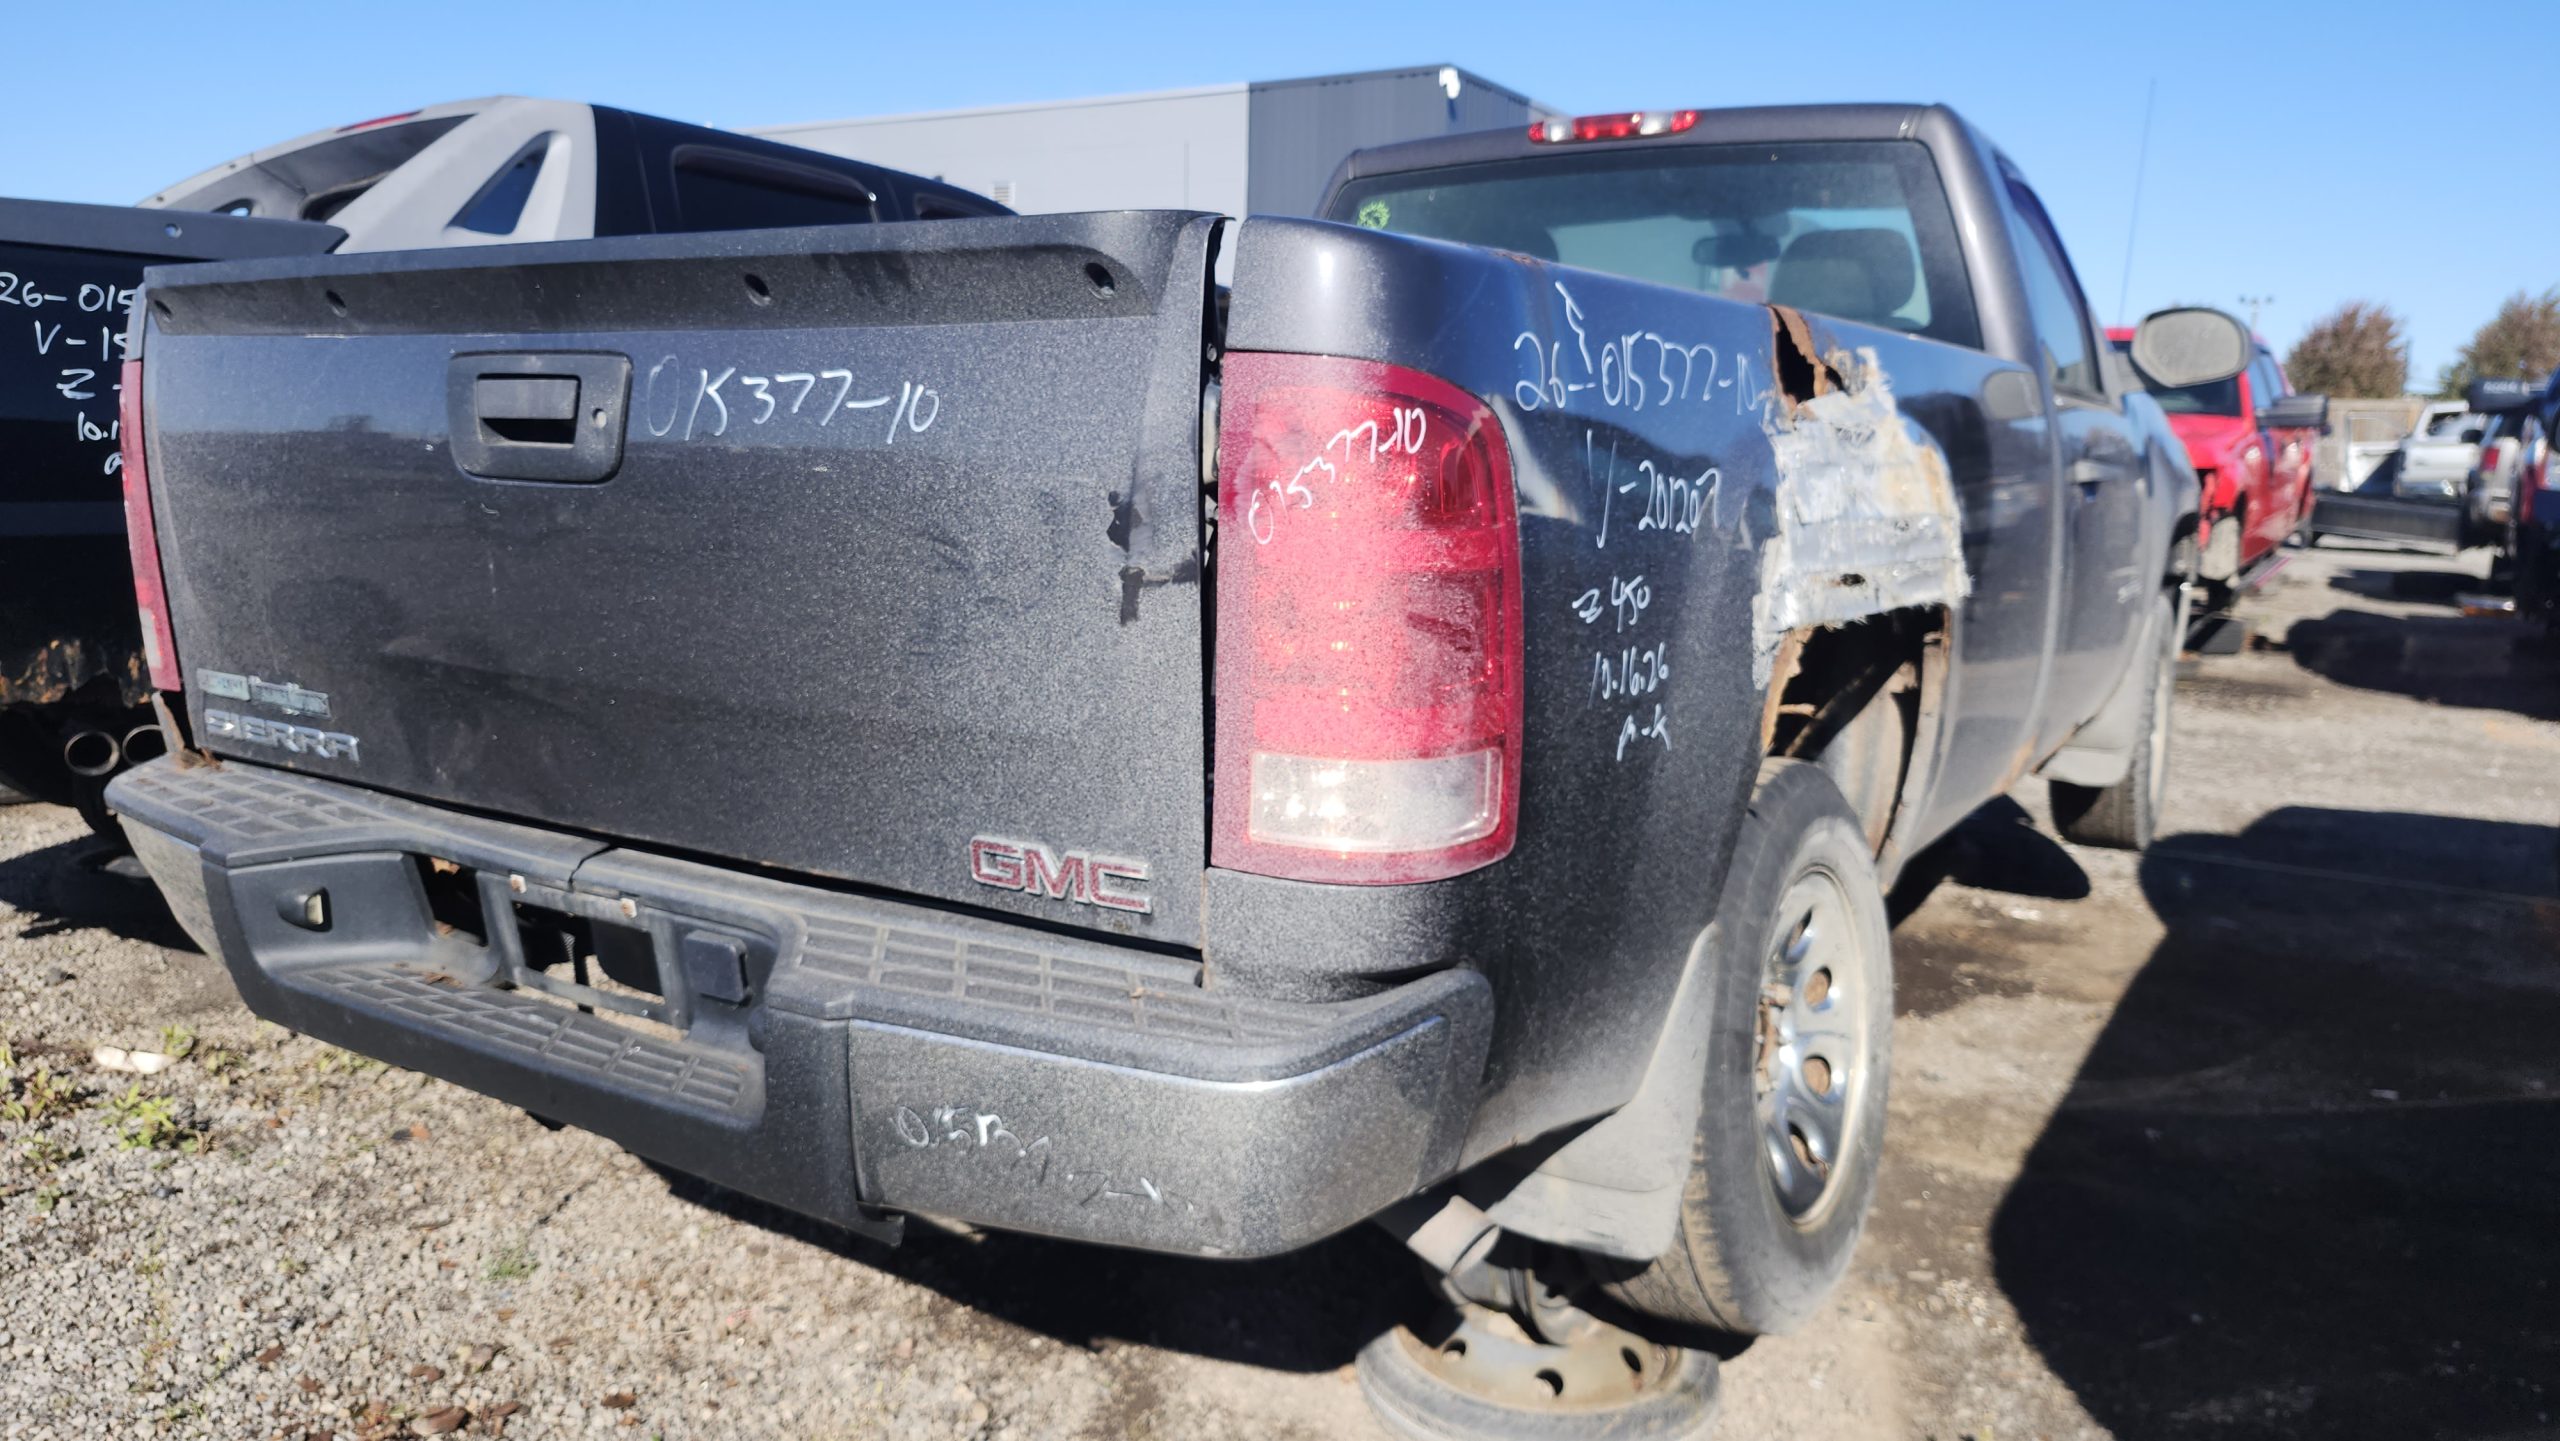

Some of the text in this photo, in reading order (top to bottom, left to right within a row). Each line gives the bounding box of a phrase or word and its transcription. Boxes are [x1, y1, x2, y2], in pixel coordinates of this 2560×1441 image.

[648, 354, 939, 444] 015377-10
[204, 707, 361, 764] SIERRA
[970, 834, 1153, 915] GMC
